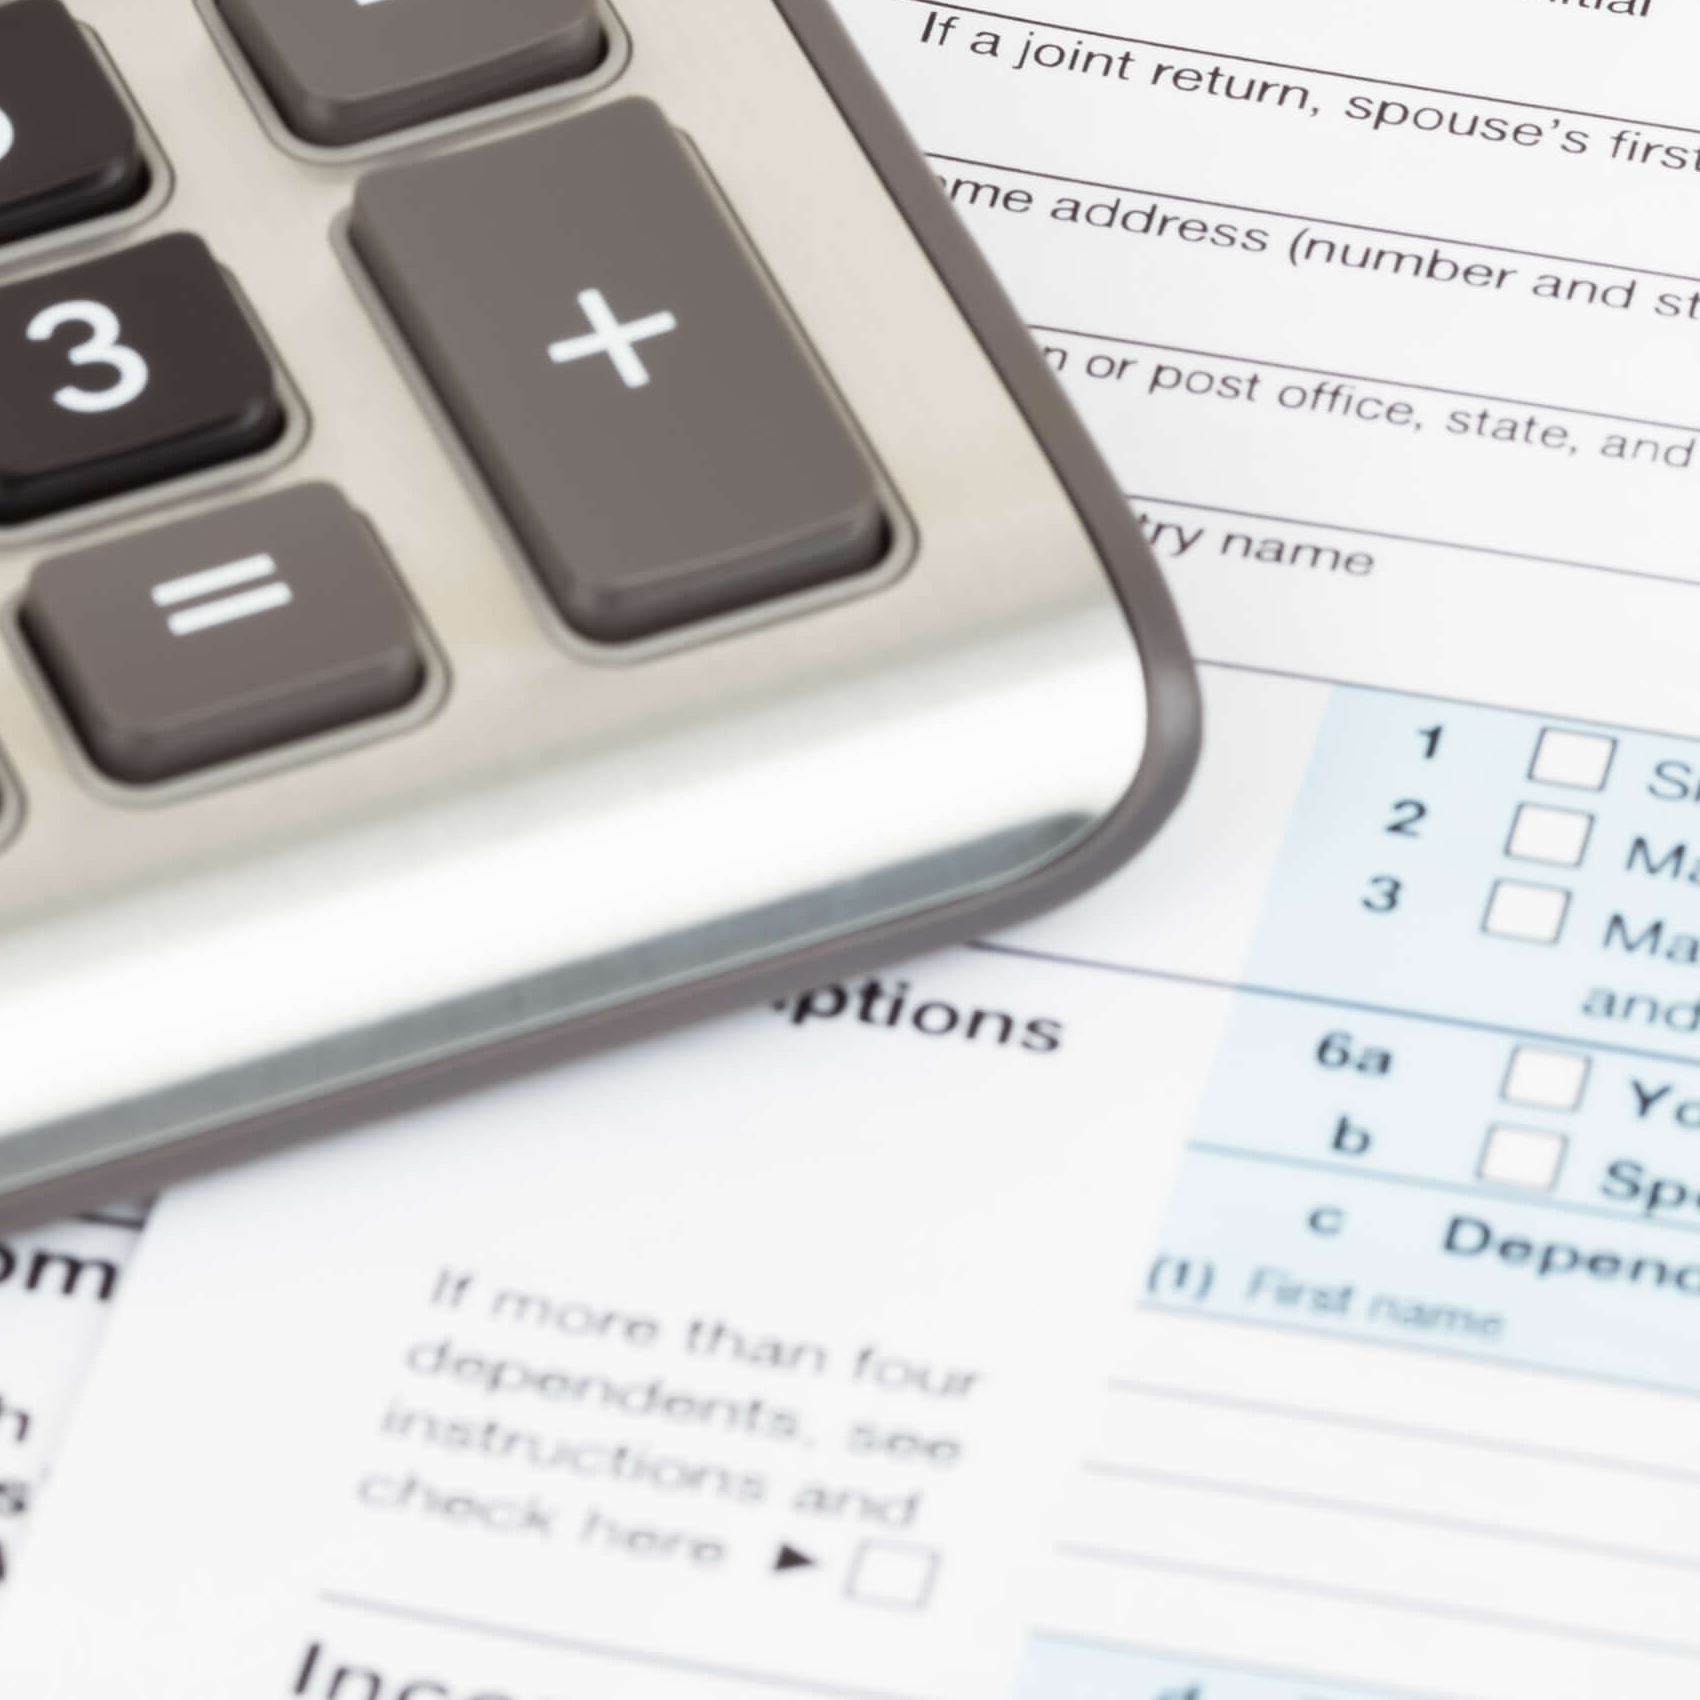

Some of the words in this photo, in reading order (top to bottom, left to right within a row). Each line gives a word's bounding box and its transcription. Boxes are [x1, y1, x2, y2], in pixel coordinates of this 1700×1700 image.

[920, 10, 961, 47] If
[969, 30, 1002, 58] a
[1011, 30, 1136, 81] joint
[1150, 62, 1319, 117] return,
[1049, 197, 1269, 253] address
[1288, 227, 1518, 290] (number
[1531, 274, 1637, 310] and
[28, 302, 146, 410] 3
[1221, 533, 1375, 575] name
[1416, 722, 1445, 762] 1
[1383, 797, 1429, 839] 2
[1360, 873, 1405, 915] 3
[1313, 1030, 1395, 1078] 6a
[1329, 1112, 1374, 1158] b
